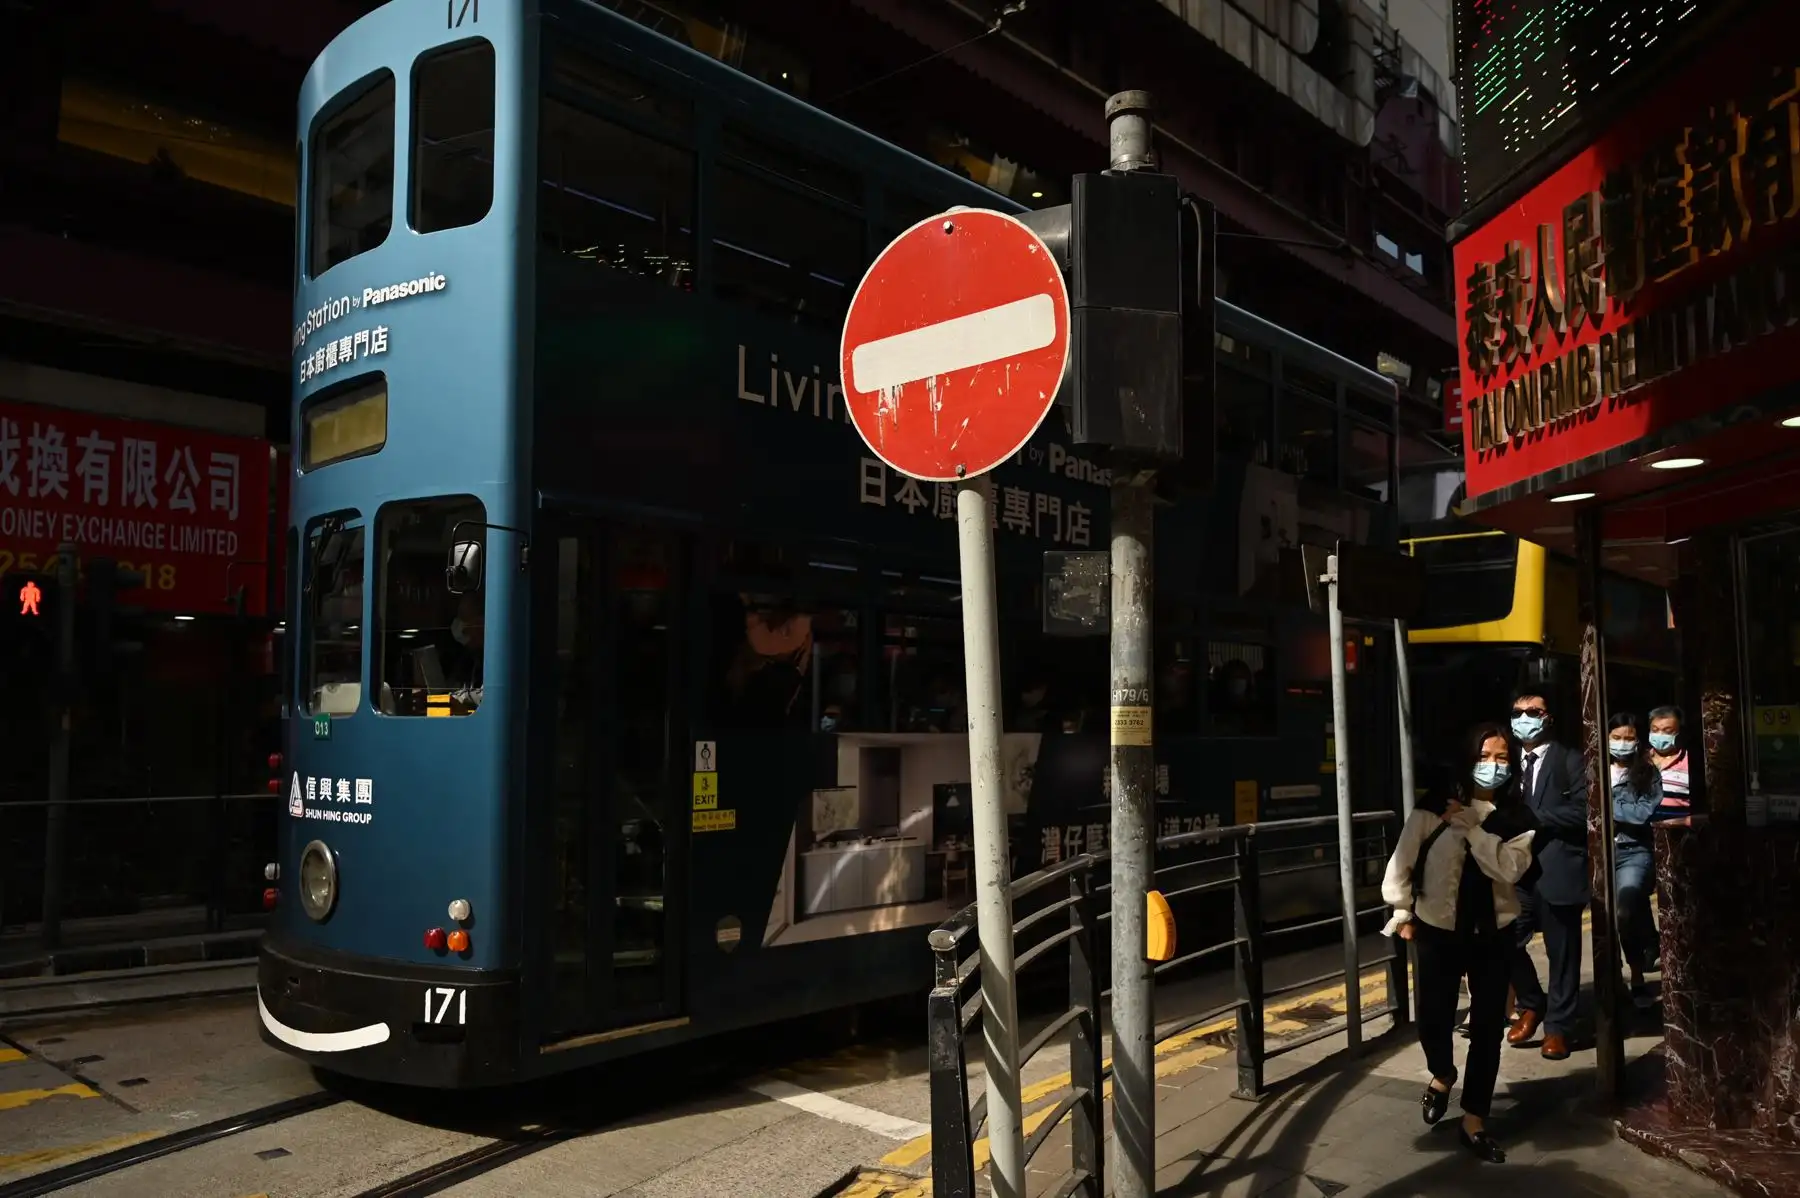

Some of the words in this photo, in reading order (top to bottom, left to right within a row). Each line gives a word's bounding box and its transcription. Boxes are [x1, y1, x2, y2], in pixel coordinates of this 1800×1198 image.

[306, 295, 350, 335] Station
[352, 296, 361, 308] by
[363, 271, 446, 308] Panasonic
[300, 325, 388, 385] 日本廚櫃專門店
[737, 343, 851, 425] Livin
[1029, 443, 1044, 467] by
[1048, 441, 1112, 488] Panas
[1467, 384, 1508, 452] TAI
[1503, 370, 1546, 437] ON
[1540, 342, 1602, 425] RMB
[0, 506, 58, 539] ONEY
[61, 512, 166, 551] EXCHANGE
[169, 521, 239, 557] LIMITED
[315, 721, 329, 736] 013
[306, 776, 373, 805] 信興集團
[695, 794, 716, 805] EXIT
[305, 808, 322, 820] SHUN
[323, 810, 341, 822] HING
[342, 811, 373, 824] GROUP
[424, 987, 467, 1025] 171
